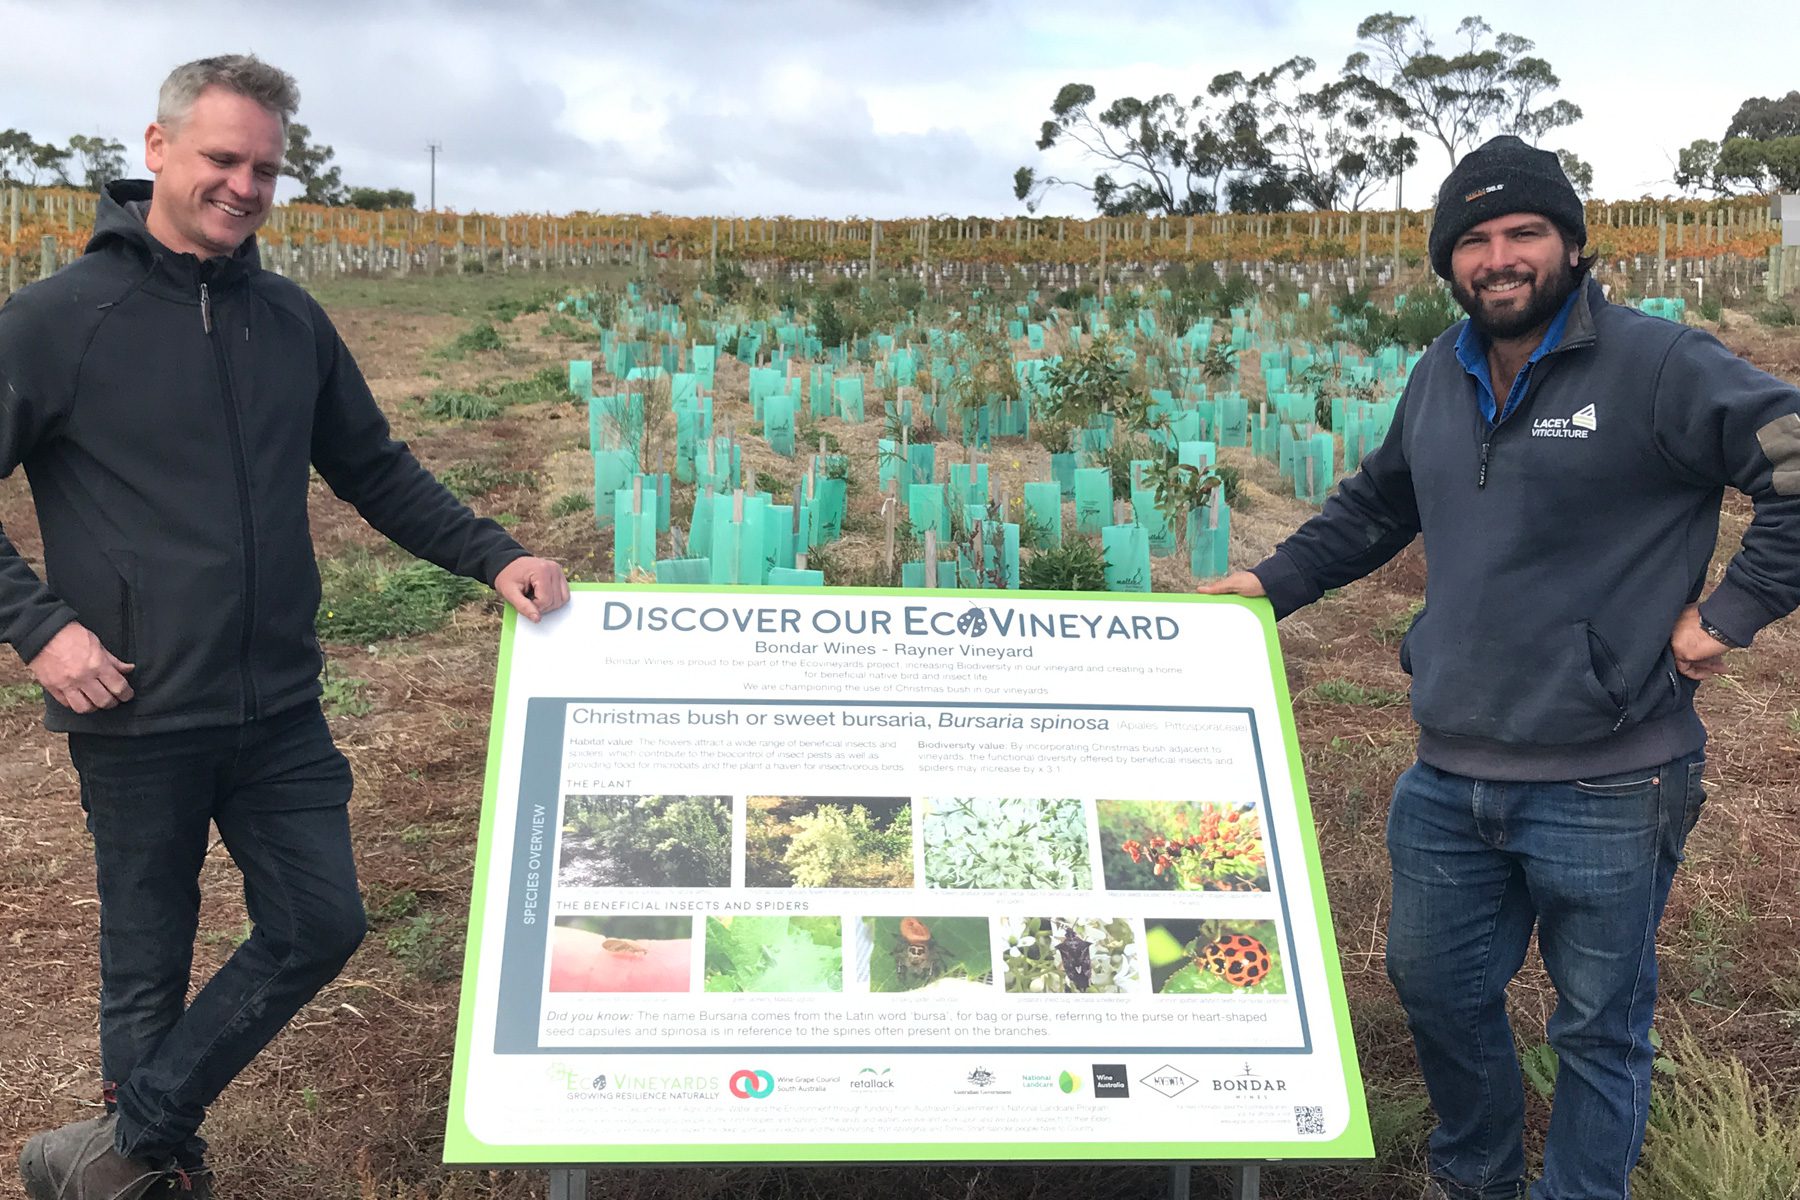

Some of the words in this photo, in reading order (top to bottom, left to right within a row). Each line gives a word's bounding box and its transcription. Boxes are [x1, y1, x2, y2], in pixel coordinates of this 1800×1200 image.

[1533, 418, 1570, 428] LACEY
[1531, 428, 1589, 438] VITICULTURE
[602, 601, 802, 634] DISCOVER
[811, 609, 892, 635] OUR
[754, 640, 820, 654] Bondar
[823, 641, 877, 655] Wines
[894, 642, 955, 659] Rayner
[958, 644, 1034, 661] Vineyard
[778, 683, 843, 694] championing
[844, 684, 861, 692] the
[863, 685, 881, 693] use
[895, 683, 945, 694] Christmas
[946, 686, 971, 694] bush
[984, 687, 1001, 695] our
[1002, 687, 1049, 697] vineyards
[572, 708, 681, 725] Christmas
[687, 709, 739, 725] bush
[746, 713, 768, 726] or
[774, 709, 835, 727] sweet
[842, 711, 932, 729] bursaria,
[938, 711, 1024, 729] Bursaria
[1030, 712, 1109, 733] spinosa
[566, 779, 590, 789] THE
[591, 779, 633, 789] PLANT
[529, 804, 546, 870] OVERVIEW
[523, 873, 540, 925] SPECIES
[555, 900, 580, 911] THE
[583, 900, 661, 911] BENEFICIAL
[664, 900, 720, 911] INSECTS
[723, 900, 753, 911] AND
[754, 900, 810, 911] SPIDERS
[546, 1010, 569, 1021] Did
[570, 1013, 594, 1024] you
[596, 1011, 634, 1021] know:
[637, 1010, 660, 1022] The
[662, 1012, 696, 1021] name
[699, 1010, 748, 1021] Bursaria
[750, 1012, 791, 1021] comes
[793, 1010, 821, 1021] from
[823, 1011, 843, 1021] the
[843, 1011, 875, 1021] Latin
[877, 1011, 907, 1021] word
[910, 1011, 953, 1021] 'bursa',
[956, 1010, 973, 1021] for
[975, 1011, 999, 1024] bag
[1000, 1012, 1014, 1022] or
[1015, 1013, 1052, 1023] purse,
[1055, 1010, 1103, 1024] referring
[1105, 1012, 1118, 1022] to
[1120, 1011, 1139, 1022] the
[1141, 1013, 1175, 1024] purse
[1176, 1013, 1189, 1022] or
[1191, 1011, 1268, 1024] heart-shaped
[545, 1026, 575, 1036] seed
[578, 1026, 632, 1038] capsules
[634, 1026, 658, 1036] and
[660, 1027, 707, 1039] spinosa
[710, 1027, 721, 1036] is
[723, 1027, 734, 1036] in
[737, 1025, 793, 1036] reference
[795, 1026, 808, 1036] to
[810, 1025, 830, 1036] the
[832, 1027, 872, 1038] spines
[874, 1025, 904, 1036] often
[907, 1025, 951, 1038] present
[954, 1027, 969, 1037] on
[972, 1025, 991, 1037] the
[993, 1025, 1050, 1037] branches.
[614, 1074, 719, 1091] VINEYARDS
[777, 1076, 794, 1084] Wine
[795, 1076, 815, 1085] Grape
[816, 1076, 841, 1084] Council
[850, 1079, 895, 1089] retallack
[1213, 1079, 1287, 1091] BONDAR
[566, 1092, 614, 1100] GROWING
[615, 1092, 667, 1100] RESILIENCE
[669, 1092, 720, 1100] NATURALLY
